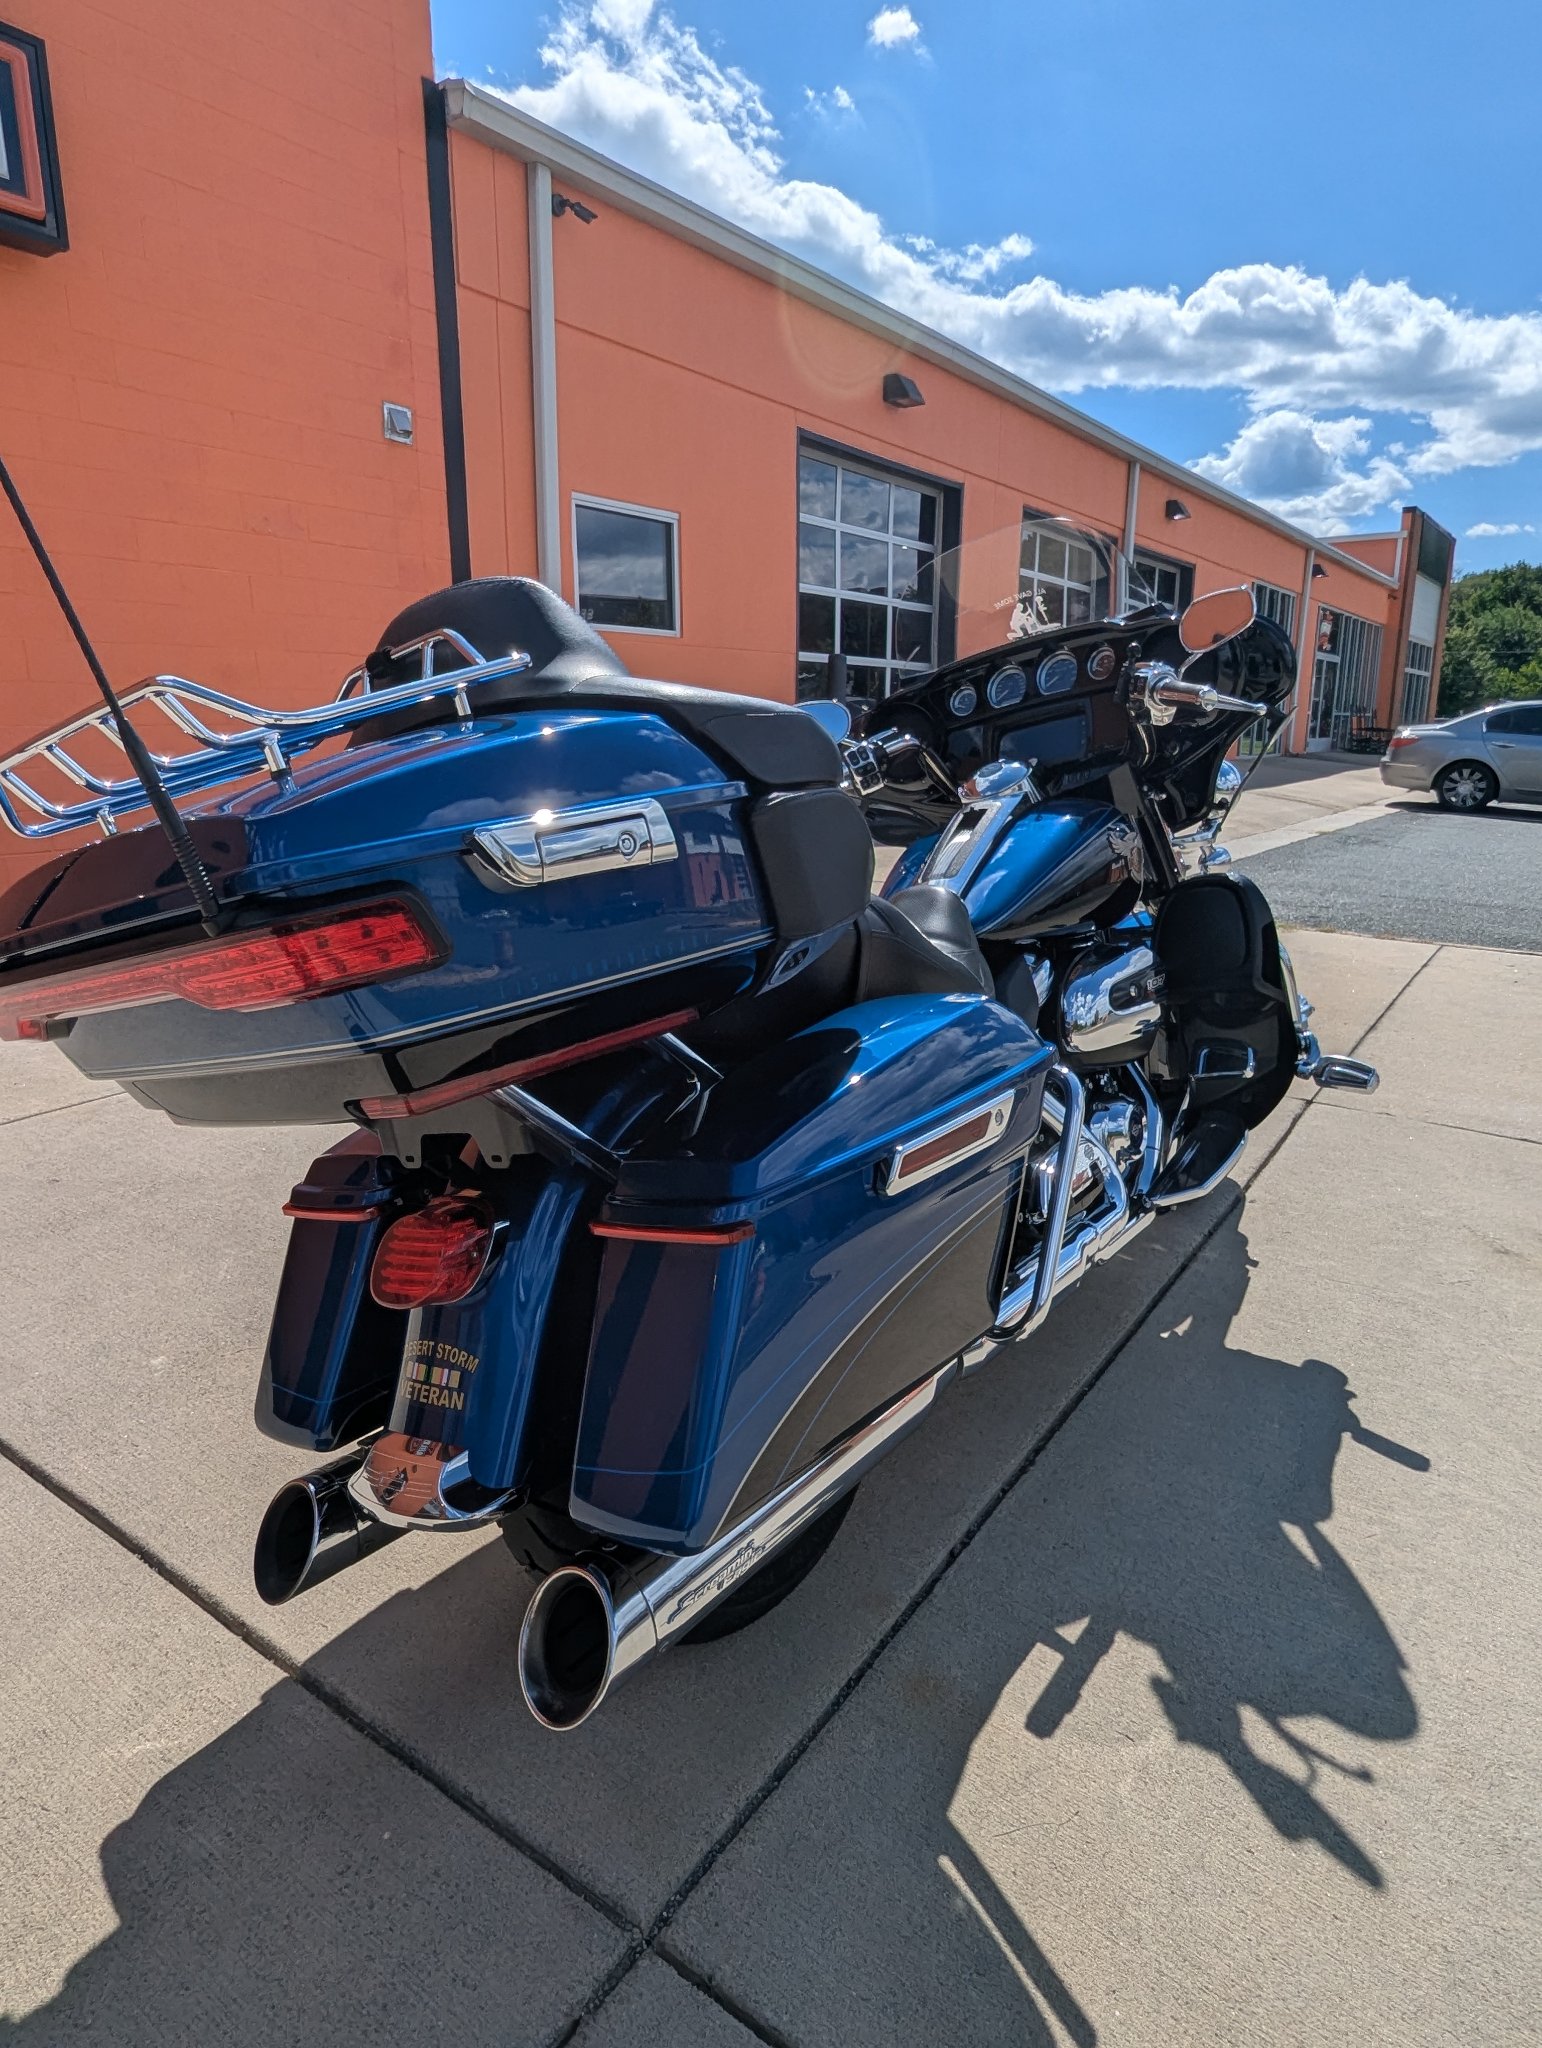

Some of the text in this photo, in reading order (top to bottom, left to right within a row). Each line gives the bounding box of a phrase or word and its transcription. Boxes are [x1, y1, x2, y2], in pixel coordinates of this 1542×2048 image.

[1147, 973, 1166, 990] 107
[436, 1343, 479, 1373] STORM
[400, 1380, 464, 1410] VETERAN
